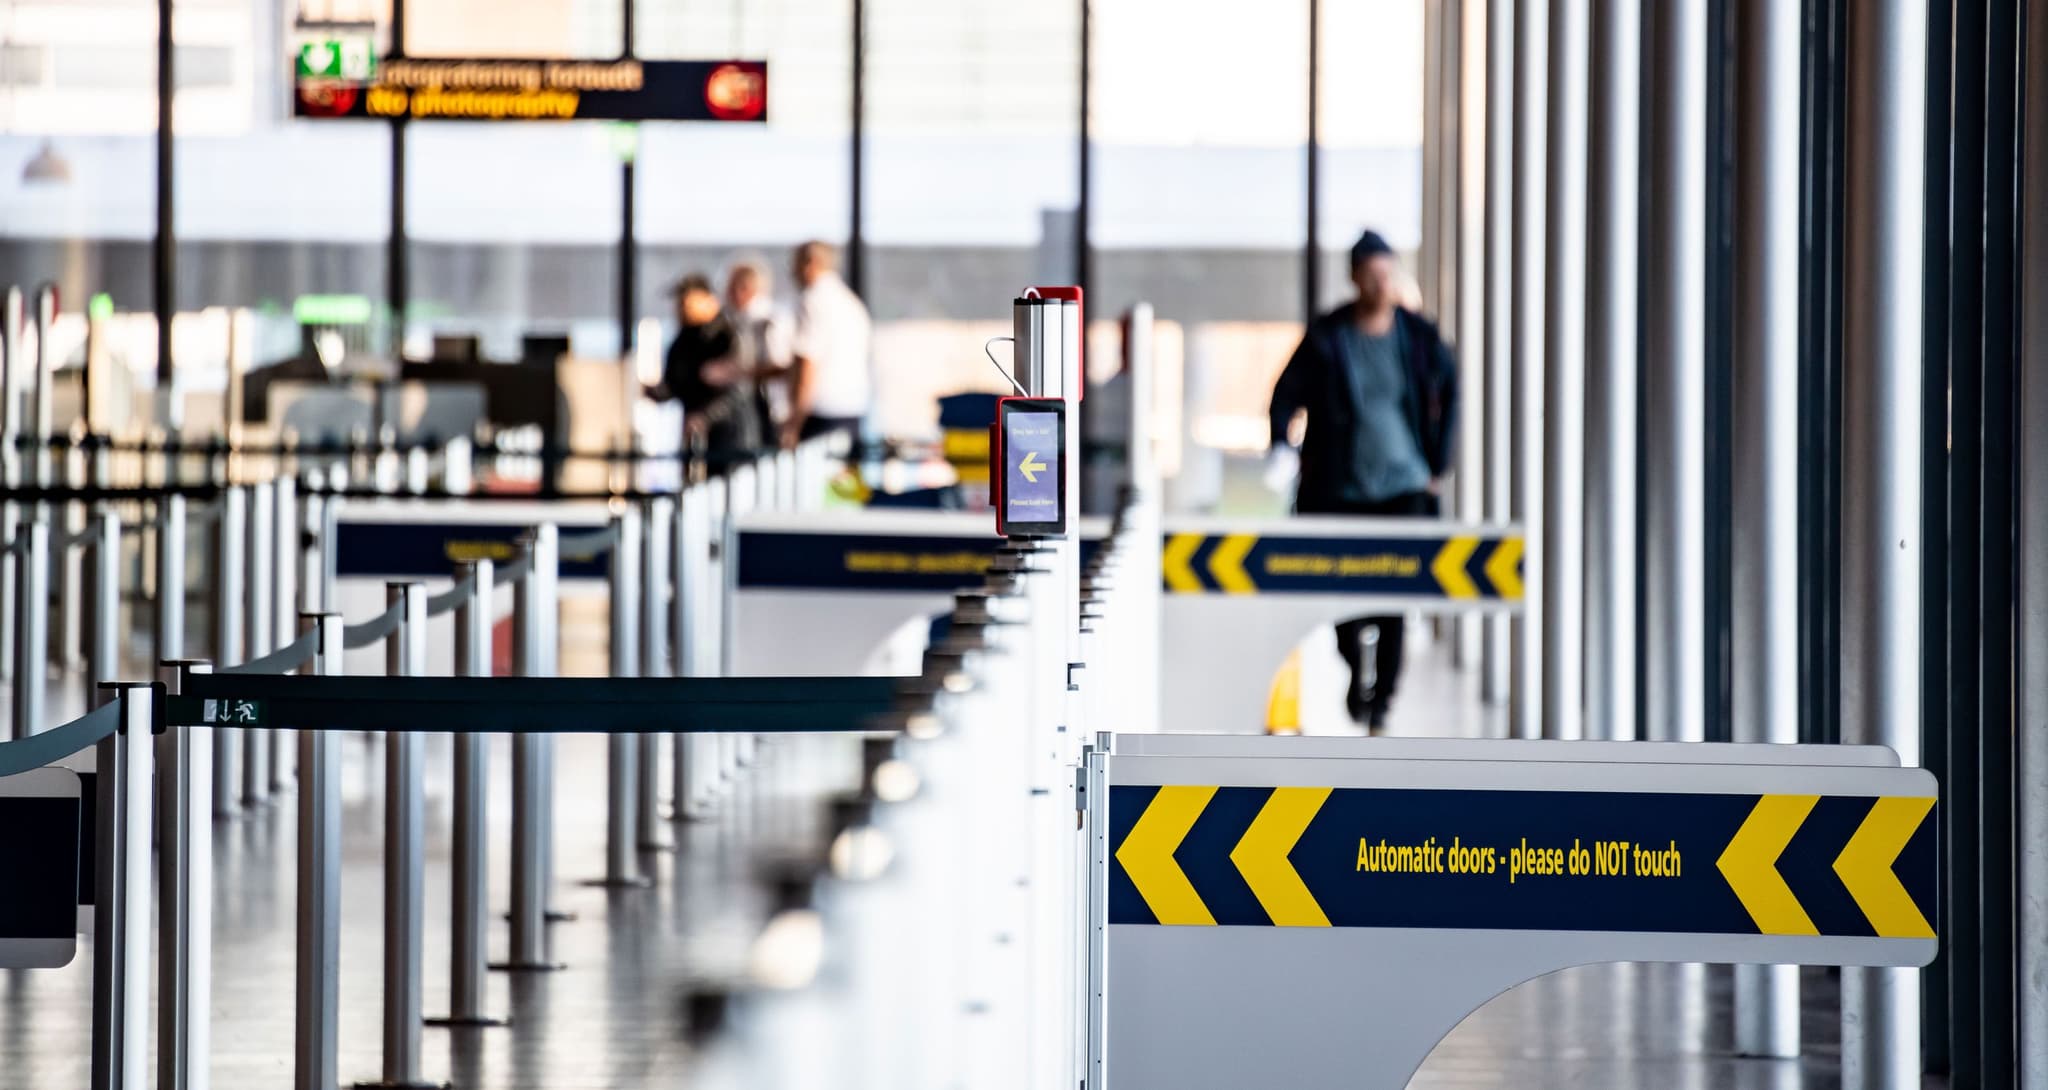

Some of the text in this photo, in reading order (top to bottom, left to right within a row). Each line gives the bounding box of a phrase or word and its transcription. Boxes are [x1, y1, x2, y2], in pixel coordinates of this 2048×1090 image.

[366, 85, 580, 119] No photography
[1356, 837, 1444, 873] Automatic
[1448, 836, 1495, 873] doors
[1510, 837, 1563, 884] please
[1568, 838, 1590, 875] do
[1595, 841, 1630, 876] NOT
[1633, 840, 1681, 877] touch
